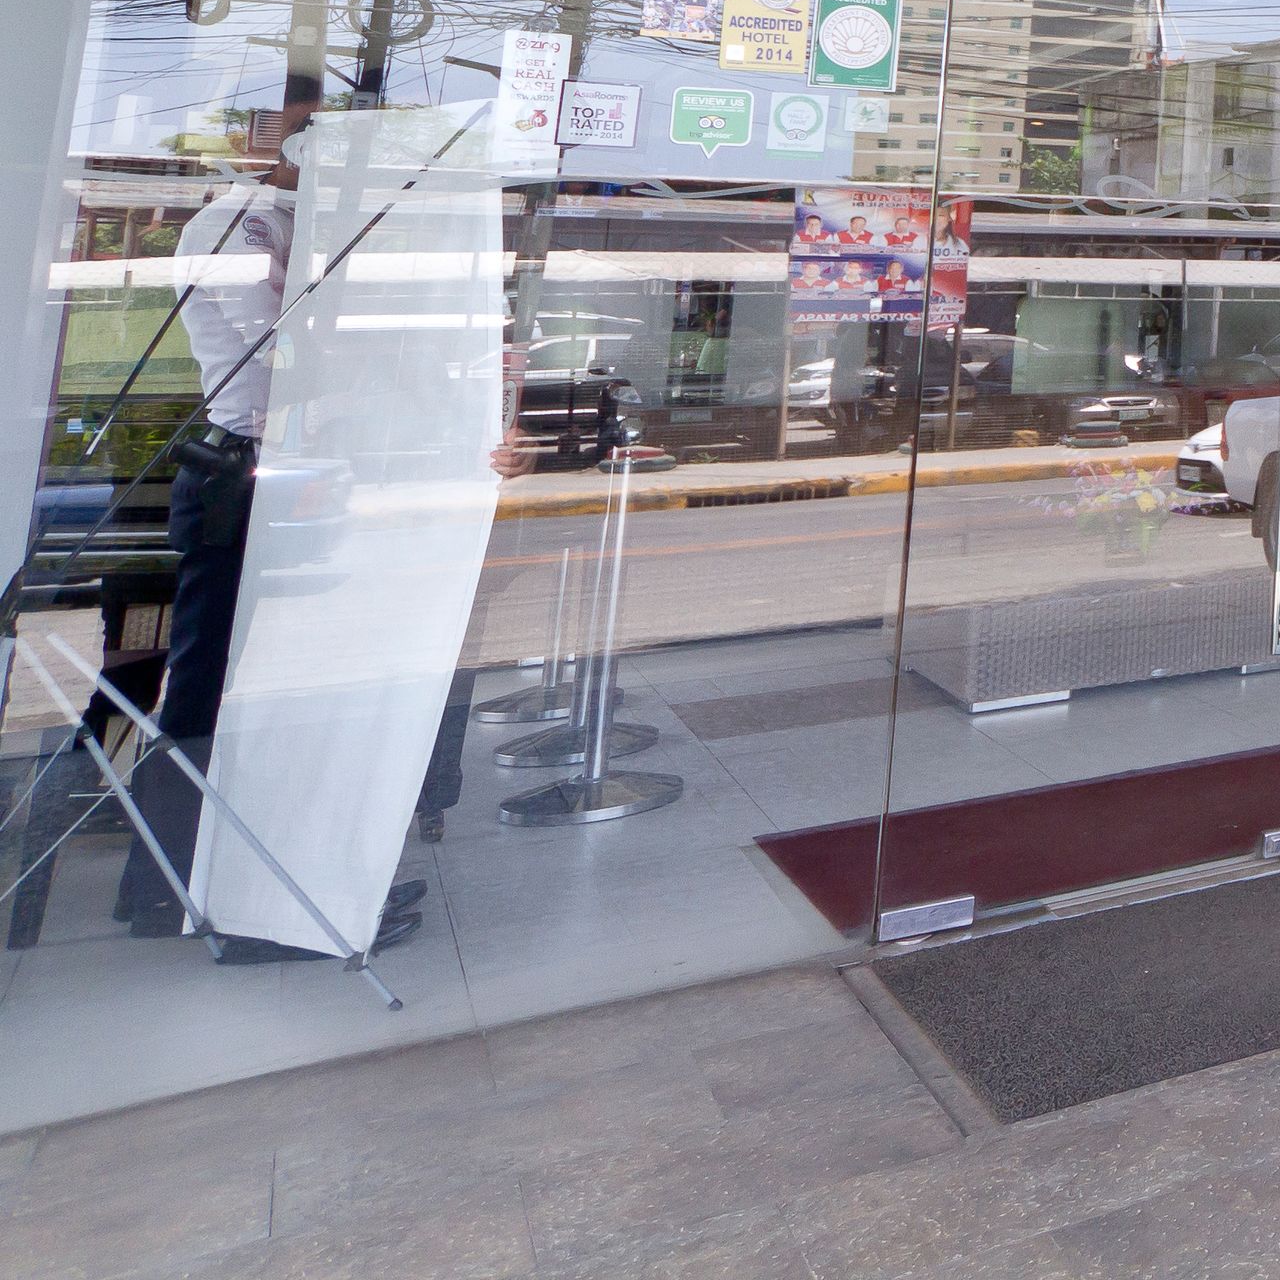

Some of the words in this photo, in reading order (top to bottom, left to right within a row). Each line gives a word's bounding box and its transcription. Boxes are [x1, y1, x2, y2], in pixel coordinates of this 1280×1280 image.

[729, 15, 803, 32] ACCREDITED
[741, 31, 789, 44] HOTEL
[756, 47, 793, 61] 2014
[525, 59, 546, 68] GET
[515, 69, 555, 80] REAL
[511, 81, 555, 93] CASH
[682, 95, 727, 106] REVIEW
[730, 97, 745, 107] US
[571, 106, 605, 119] TOP
[570, 118, 625, 132] RATED
[600, 131, 623, 140] 2014
